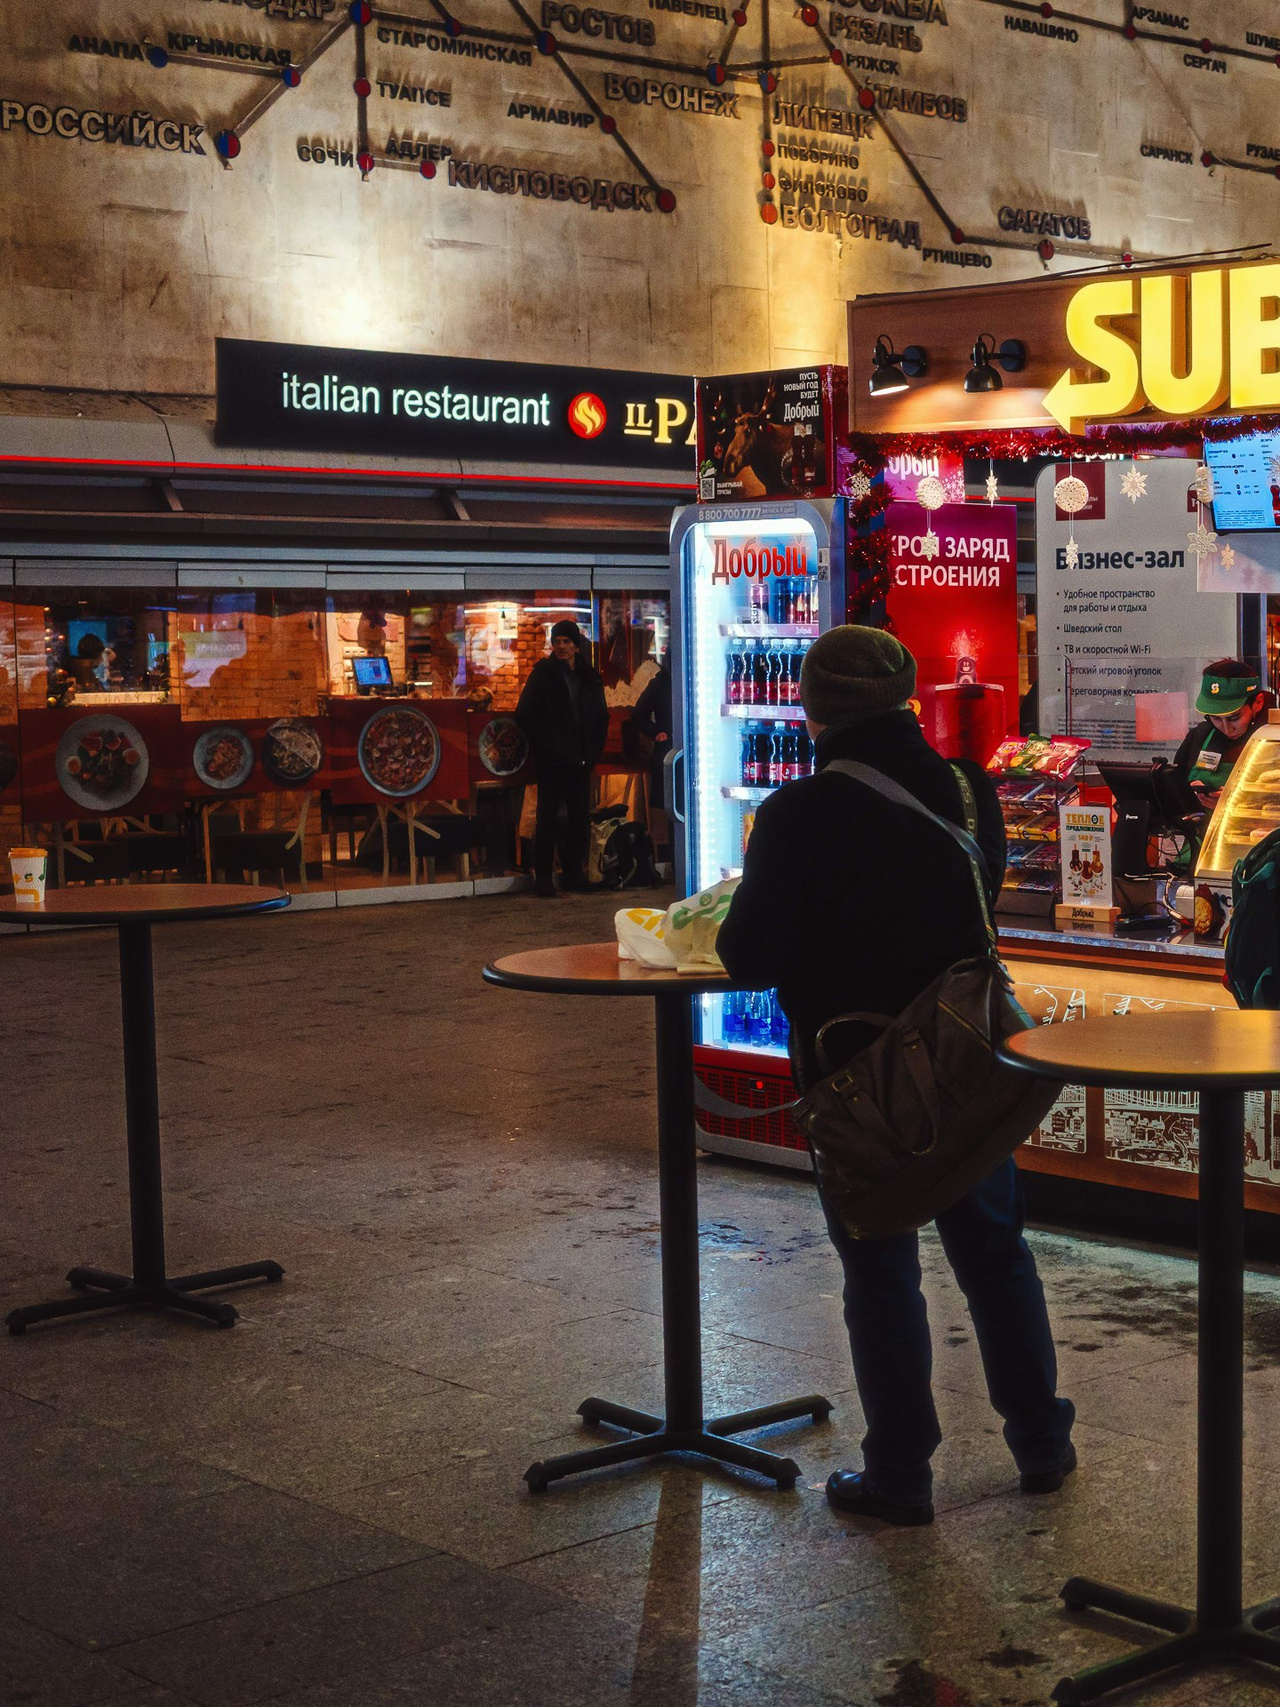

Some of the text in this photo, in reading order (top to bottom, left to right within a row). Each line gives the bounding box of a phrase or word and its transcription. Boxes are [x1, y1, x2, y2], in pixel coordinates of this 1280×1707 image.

[541, 2, 656, 46] РОСТОВ
[1004, 16, 1079, 43] НАВАШИНО
[1132, 6, 1189, 30] АРЗАМАС
[829, 12, 924, 53] РЯЗАНЬ
[68, 34, 145, 62] АНАПА
[167, 31, 292, 66] КРЫМСКАЯ
[376, 27, 533, 67] СТАРОМИНСКАЯ
[846, 53, 900, 76] РЯЖСК
[1183, 54, 1227, 74] СЕРГАЧ
[376, 80, 451, 108] ТУАПСЕ
[604, 73, 742, 119] ВОРОНЕЖ
[874, 83, 968, 123] ТАМБОВ
[507, 102, 595, 129] АРМАВИР
[773, 101, 875, 140] ЛИПЕЦК
[299, 144, 354, 168] СОЧИ
[385, 137, 452, 162] АДЛЕР
[777, 143, 860, 170] ПОВОРИНО
[1140, 145, 1194, 165] САРАНСК
[448, 160, 654, 213] КИСЛОВОДСК
[781, 204, 921, 250] ВОЛГОГРАД
[999, 206, 1091, 240] САРАТОВ
[922, 247, 992, 269] РТИЩЕВО
[799, 372, 819, 381] ПУСТЬ
[807, 382, 819, 391] ГОД
[282, 371, 550, 427] italian restaurant
[800, 391, 819, 399] БУДЕТ
[624, 402, 653, 429] IL
[784, 400, 819, 422] Добрый
[712, 536, 808, 585] Добрый
[945, 538, 1010, 562] ЗАРЯД
[895, 564, 1000, 588] СТРОЕНИЯ
[1063, 589, 1155, 600] Удобное пространство
[1063, 604, 1077, 613] для
[1079, 603, 1109, 614] работы
[1118, 604, 1147, 613] отдыха
[1063, 623, 1122, 633] Шведский стол
[1064, 645, 1074, 654] ТВ
[1083, 644, 1129, 655] скоростной
[1130, 644, 1151, 654] Wi-Fi
[1098, 664, 1162, 676] игровой уголок
